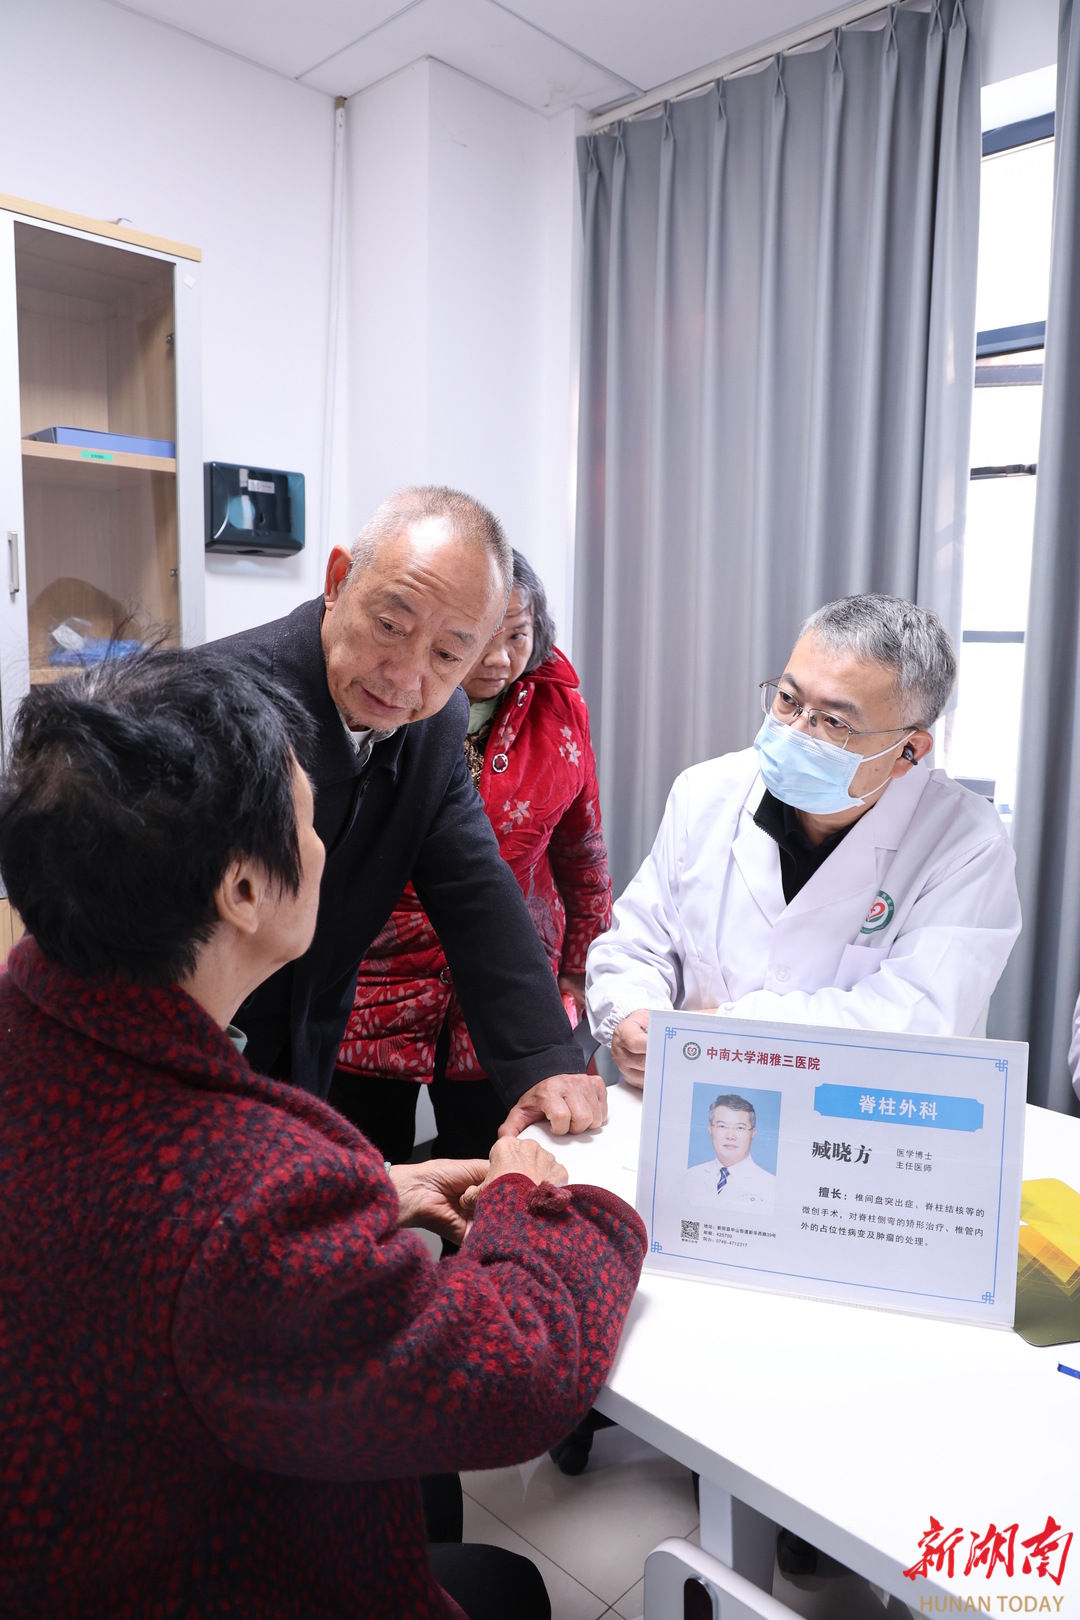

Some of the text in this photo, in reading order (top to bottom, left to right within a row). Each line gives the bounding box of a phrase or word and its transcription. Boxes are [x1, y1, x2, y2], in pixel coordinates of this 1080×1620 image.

[706, 1046, 820, 1071] 中南大学湘雅三医院
[858, 1094, 939, 1121] 脊柱外科
[811, 1140, 872, 1165] 臧晓方
[896, 1148, 933, 1160] 医学博士
[895, 1161, 933, 1173] 主任医师
[800, 1221, 929, 1247] 外的占位性病变及肿瘤的处理。
